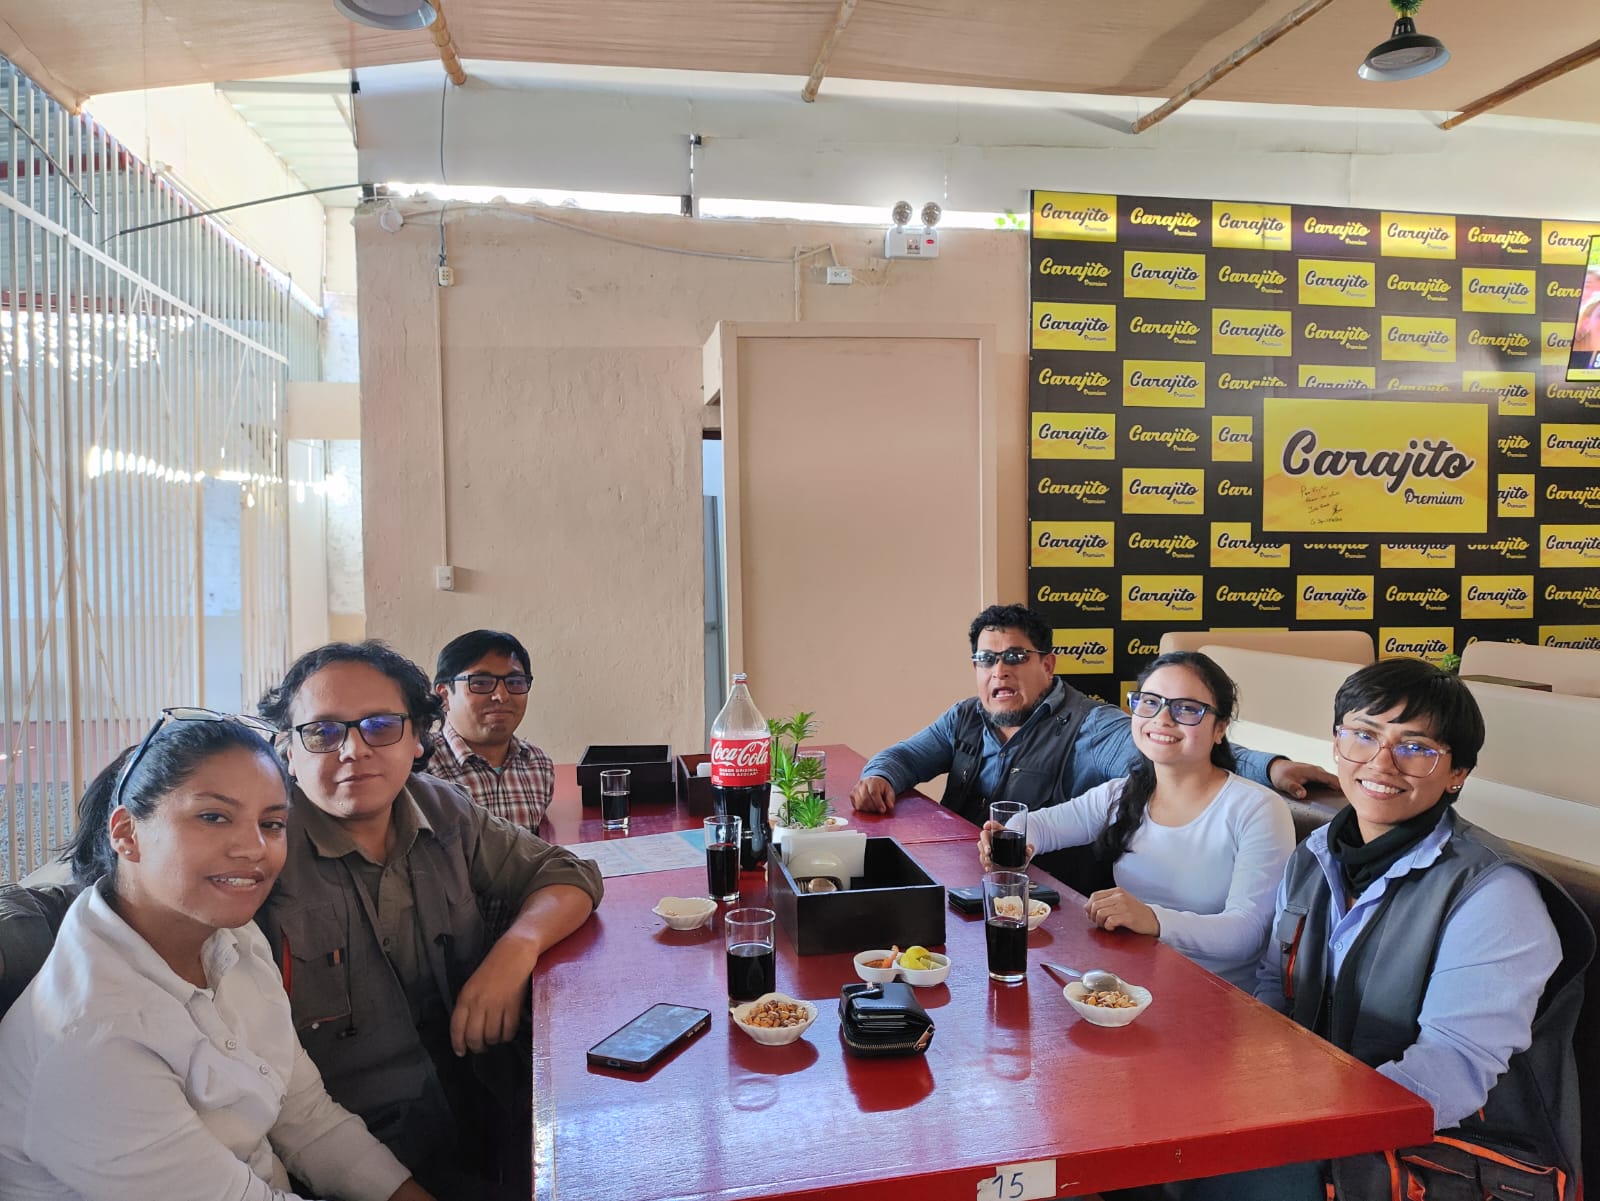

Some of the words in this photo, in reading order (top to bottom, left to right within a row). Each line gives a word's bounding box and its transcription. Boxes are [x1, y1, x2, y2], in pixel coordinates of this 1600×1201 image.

[1041, 203, 1110, 226] Carajito
[1130, 207, 1200, 231] Carajito
[1218, 213, 1285, 236] Carajito
[1304, 217, 1370, 240] Carajito
[1387, 223, 1450, 245] Carajito
[1468, 226, 1531, 249] Carajito
[1040, 257, 1111, 282] Carajito
[1131, 263, 1199, 285] Carajito
[1218, 266, 1287, 288] Carajito
[1305, 270, 1369, 292] Carajito
[1387, 274, 1451, 296] Carajito
[1469, 278, 1529, 300] Carajito
[1040, 313, 1110, 336] Carajito
[1130, 316, 1200, 339] Carajito
[1218, 320, 1285, 342] Carajito
[1305, 323, 1370, 346] Carajito
[1388, 327, 1450, 349] Carajito
[1468, 330, 1531, 351] Carajito
[1039, 368, 1110, 391] Carajito
[1130, 371, 1199, 393] Carajito
[1038, 423, 1109, 445] Carajito
[1129, 424, 1199, 446] Carajito
[1283, 430, 1474, 492] Carajito
[1038, 477, 1109, 500] Carajito
[1129, 479, 1199, 500] Carajito
[1405, 488, 1464, 505] Premium
[1038, 532, 1109, 553] Carajito
[1129, 532, 1199, 554] Carajito
[1038, 585, 1108, 607] Carajito
[1128, 586, 1197, 606] Carajito
[1216, 585, 1284, 607] Carajito
[1303, 586, 1368, 605] Carajito
[1386, 585, 1449, 606] Carajito
[1467, 586, 1528, 605] Carajito
[1385, 638, 1448, 657] Carajito
[711, 740, 769, 766] Coca-Cola
[992, 1172, 1024, 1198] 15
